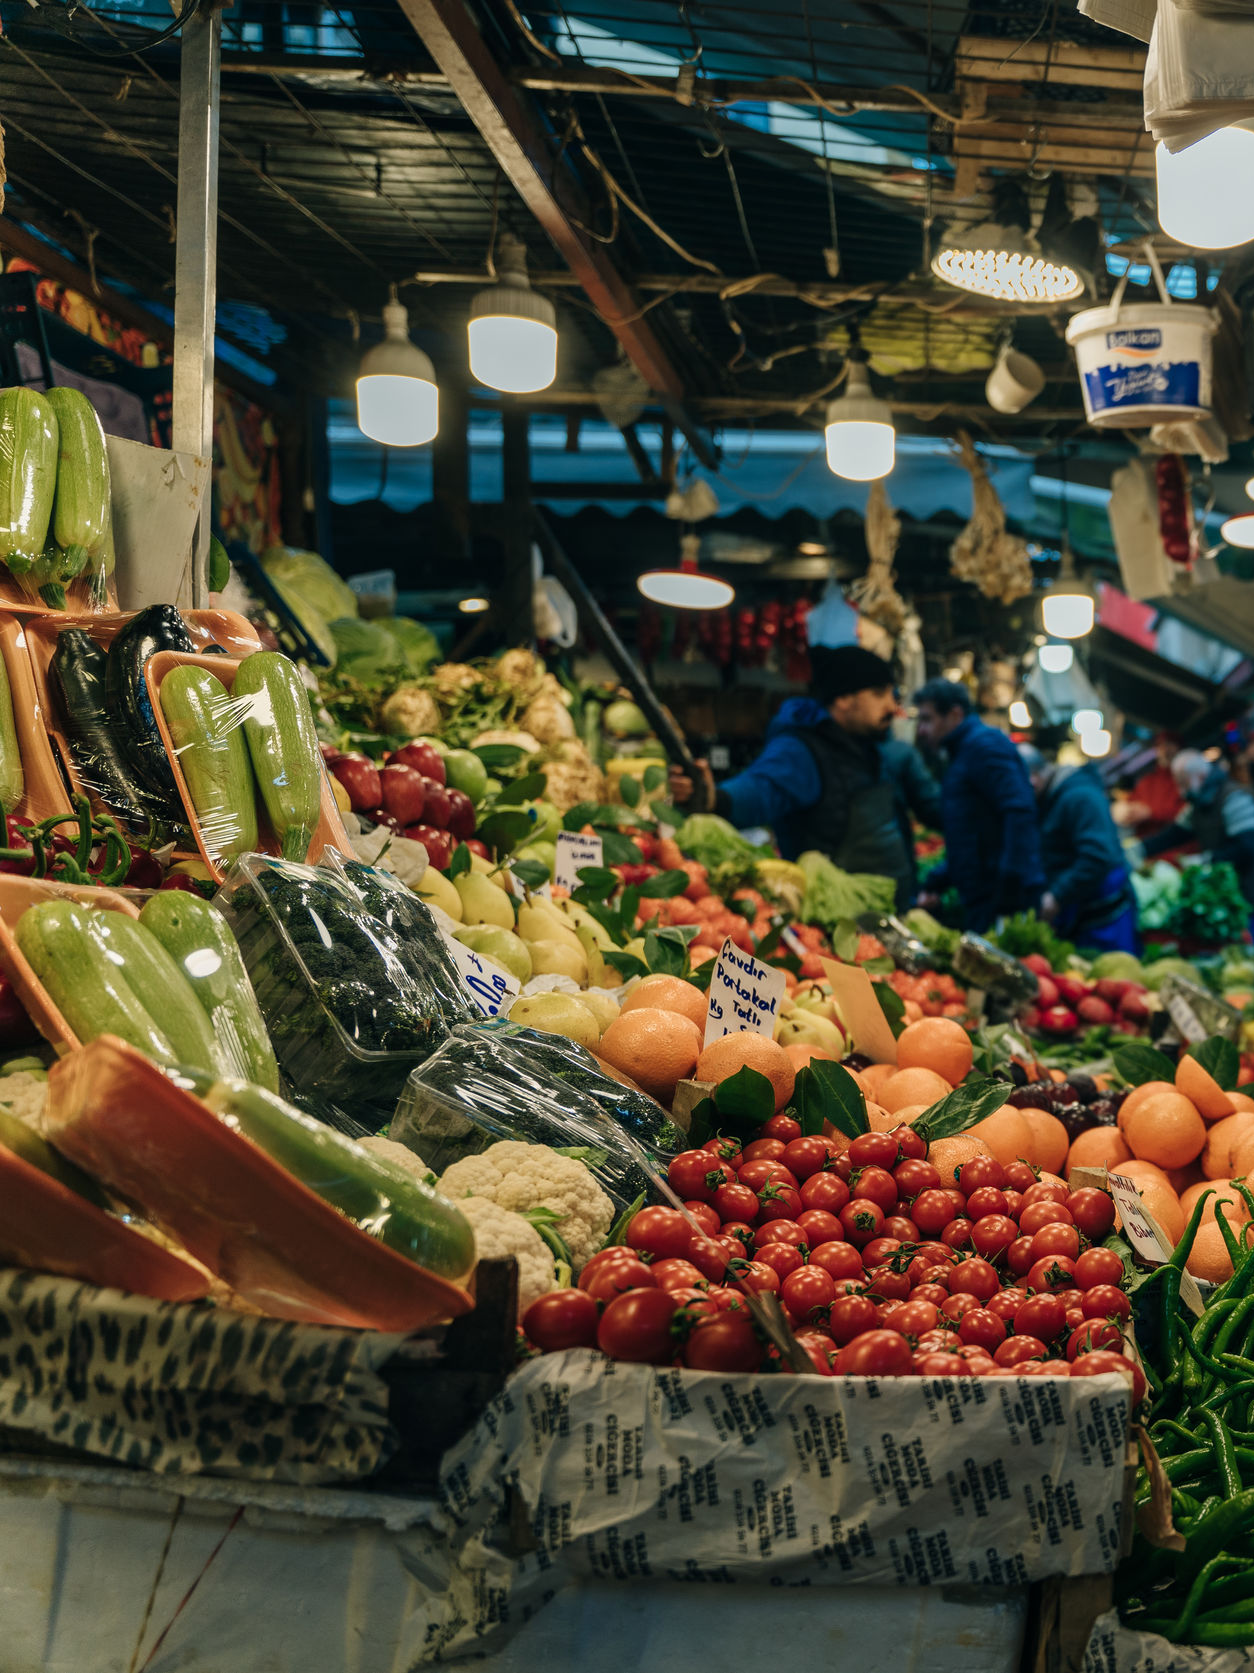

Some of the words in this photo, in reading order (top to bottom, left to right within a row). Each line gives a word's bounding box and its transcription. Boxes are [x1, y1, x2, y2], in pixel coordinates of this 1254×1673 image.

[1106, 1407, 1122, 1448] MODA
[622, 1429, 633, 1477] MODA
[901, 1443, 920, 1488] MODA
